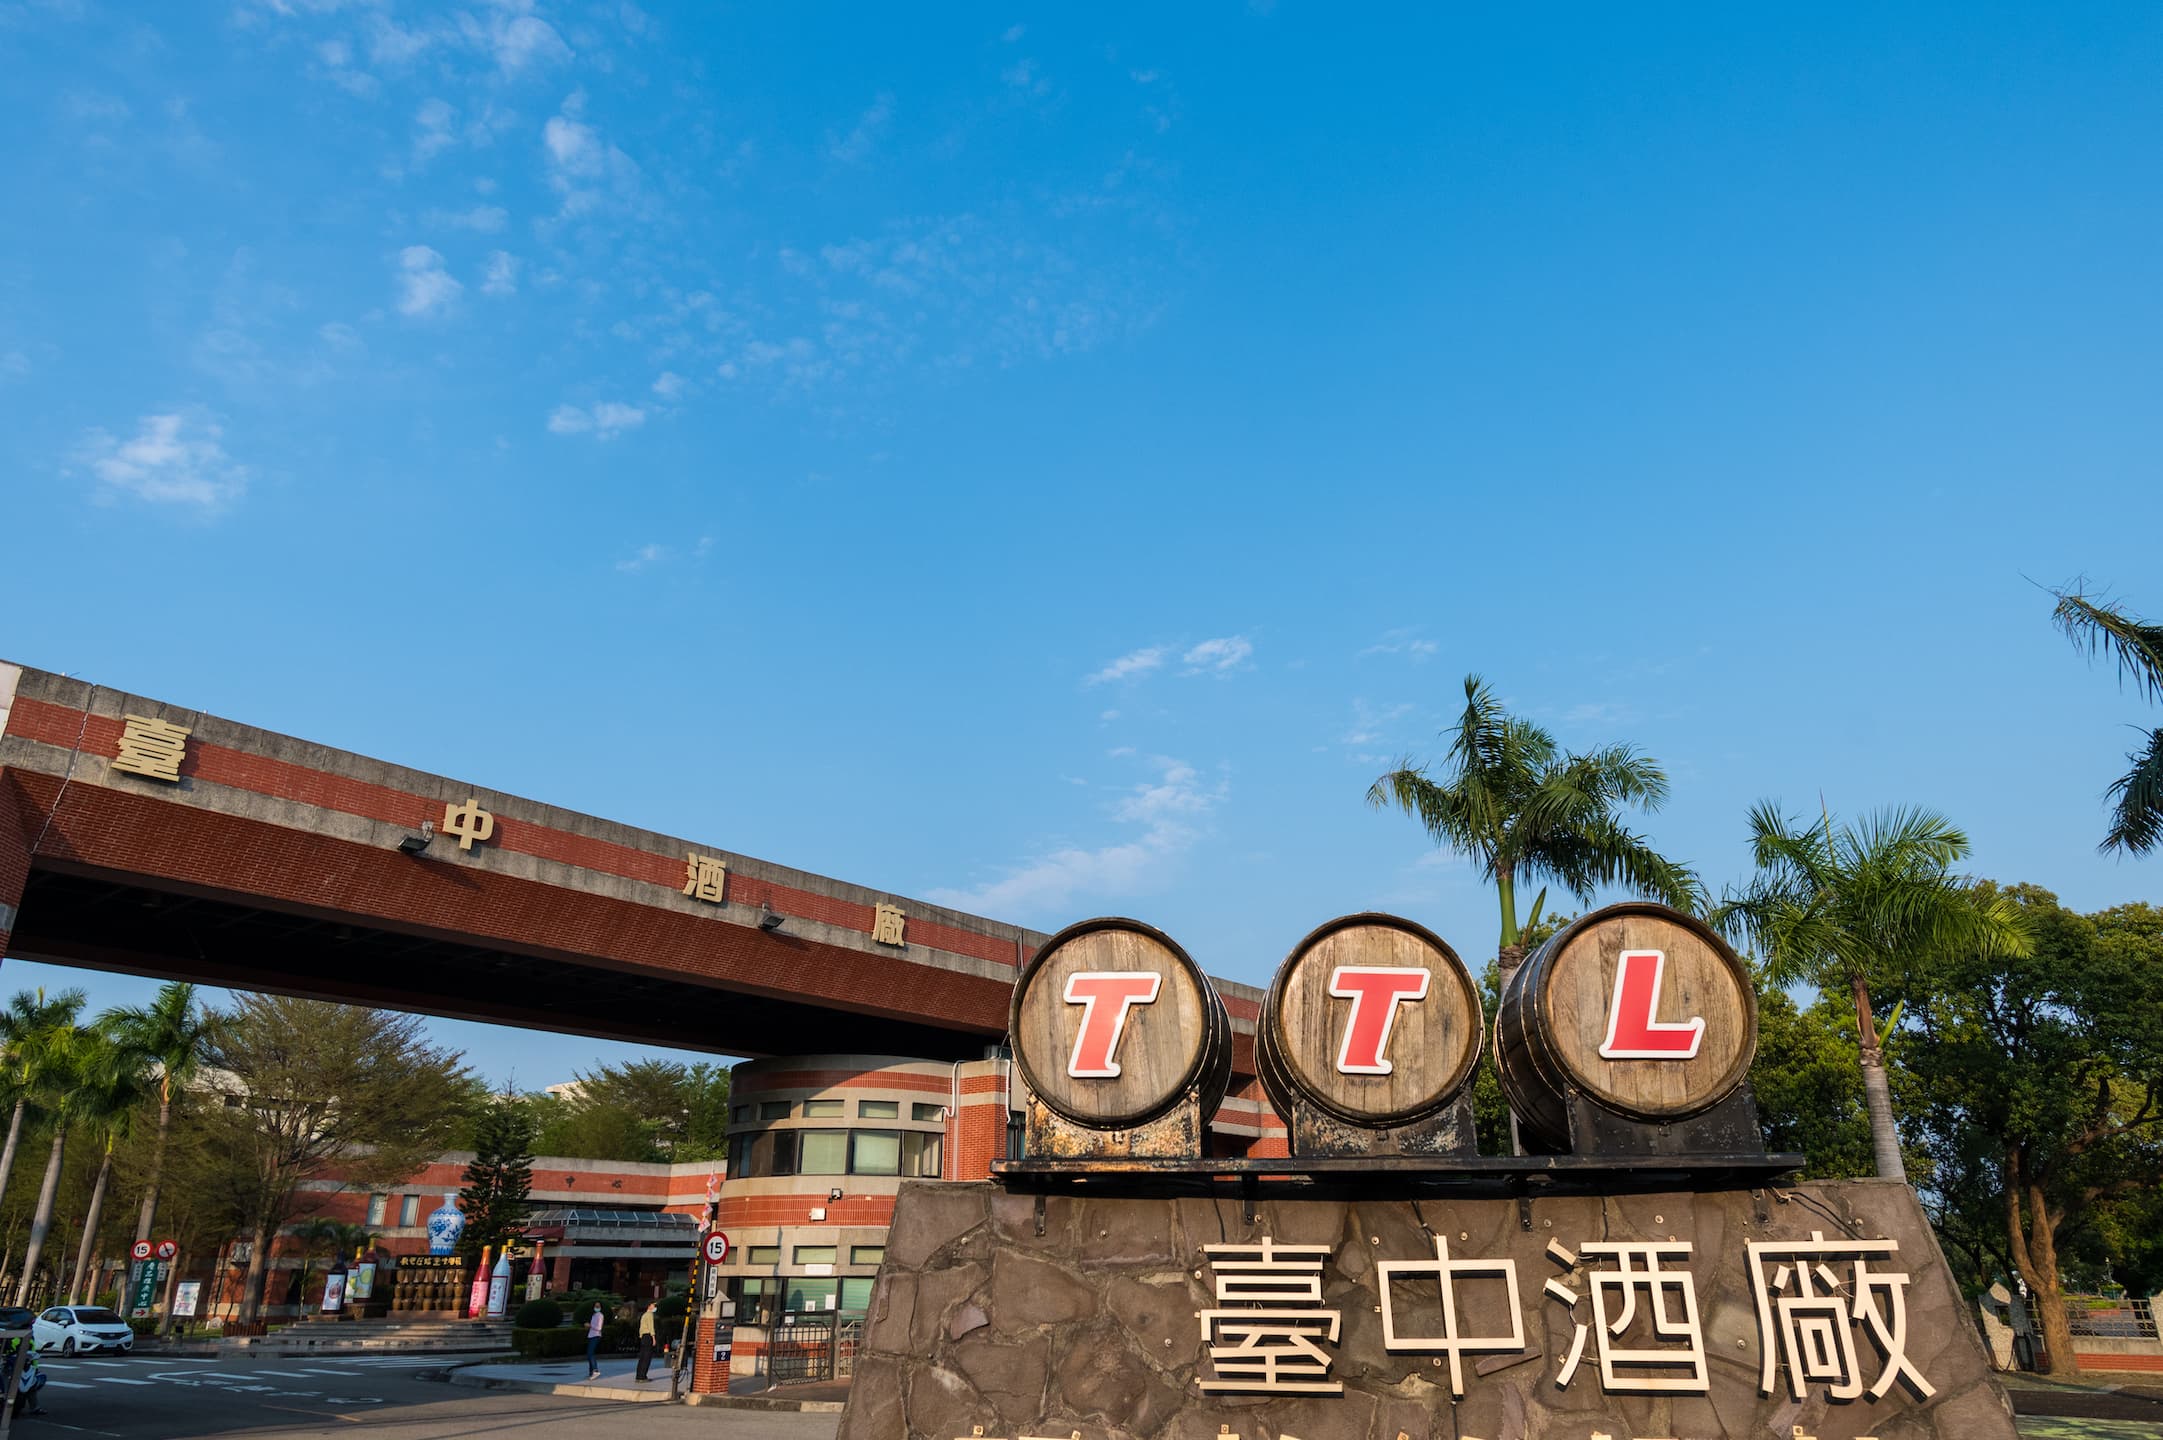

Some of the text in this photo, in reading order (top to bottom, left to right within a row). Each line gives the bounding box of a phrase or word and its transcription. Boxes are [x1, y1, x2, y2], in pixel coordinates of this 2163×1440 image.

[137, 1246, 148, 1254] 15
[710, 1242, 722, 1254] 15
[1199, 1231, 1937, 1400] 臺中酒廠
